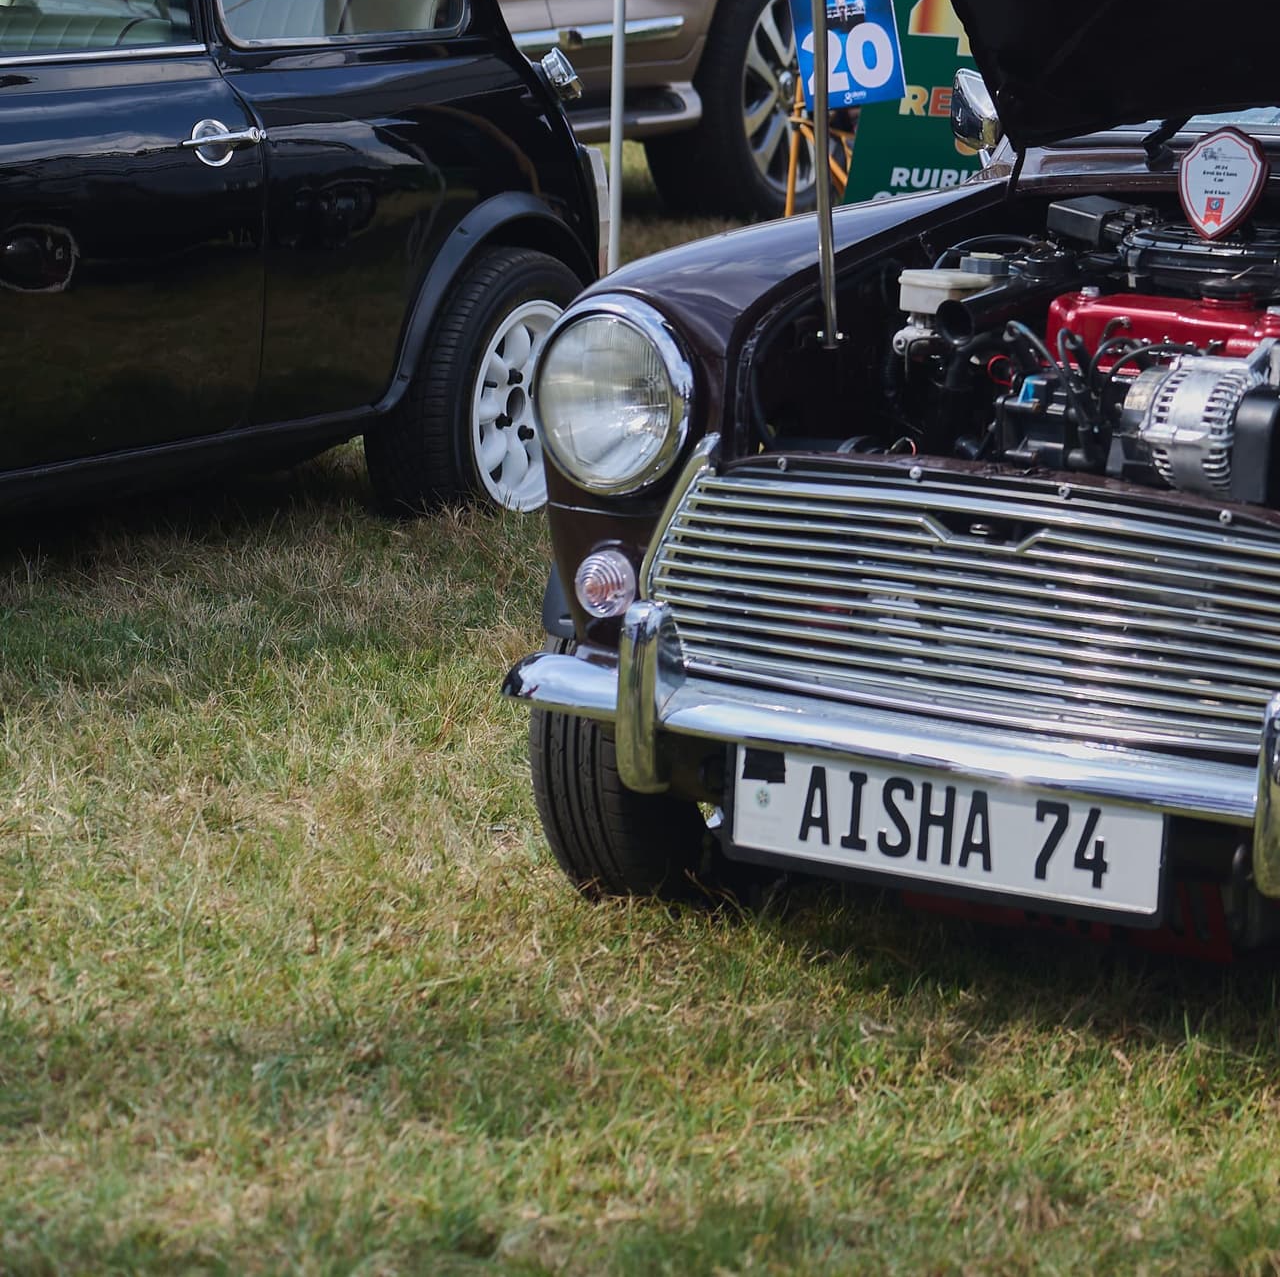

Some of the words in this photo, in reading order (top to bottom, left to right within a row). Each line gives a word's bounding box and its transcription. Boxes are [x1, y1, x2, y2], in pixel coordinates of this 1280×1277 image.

[801, 22, 895, 96] 20
[798, 765, 993, 872] AISHA
[1033, 799, 1109, 890] 74
